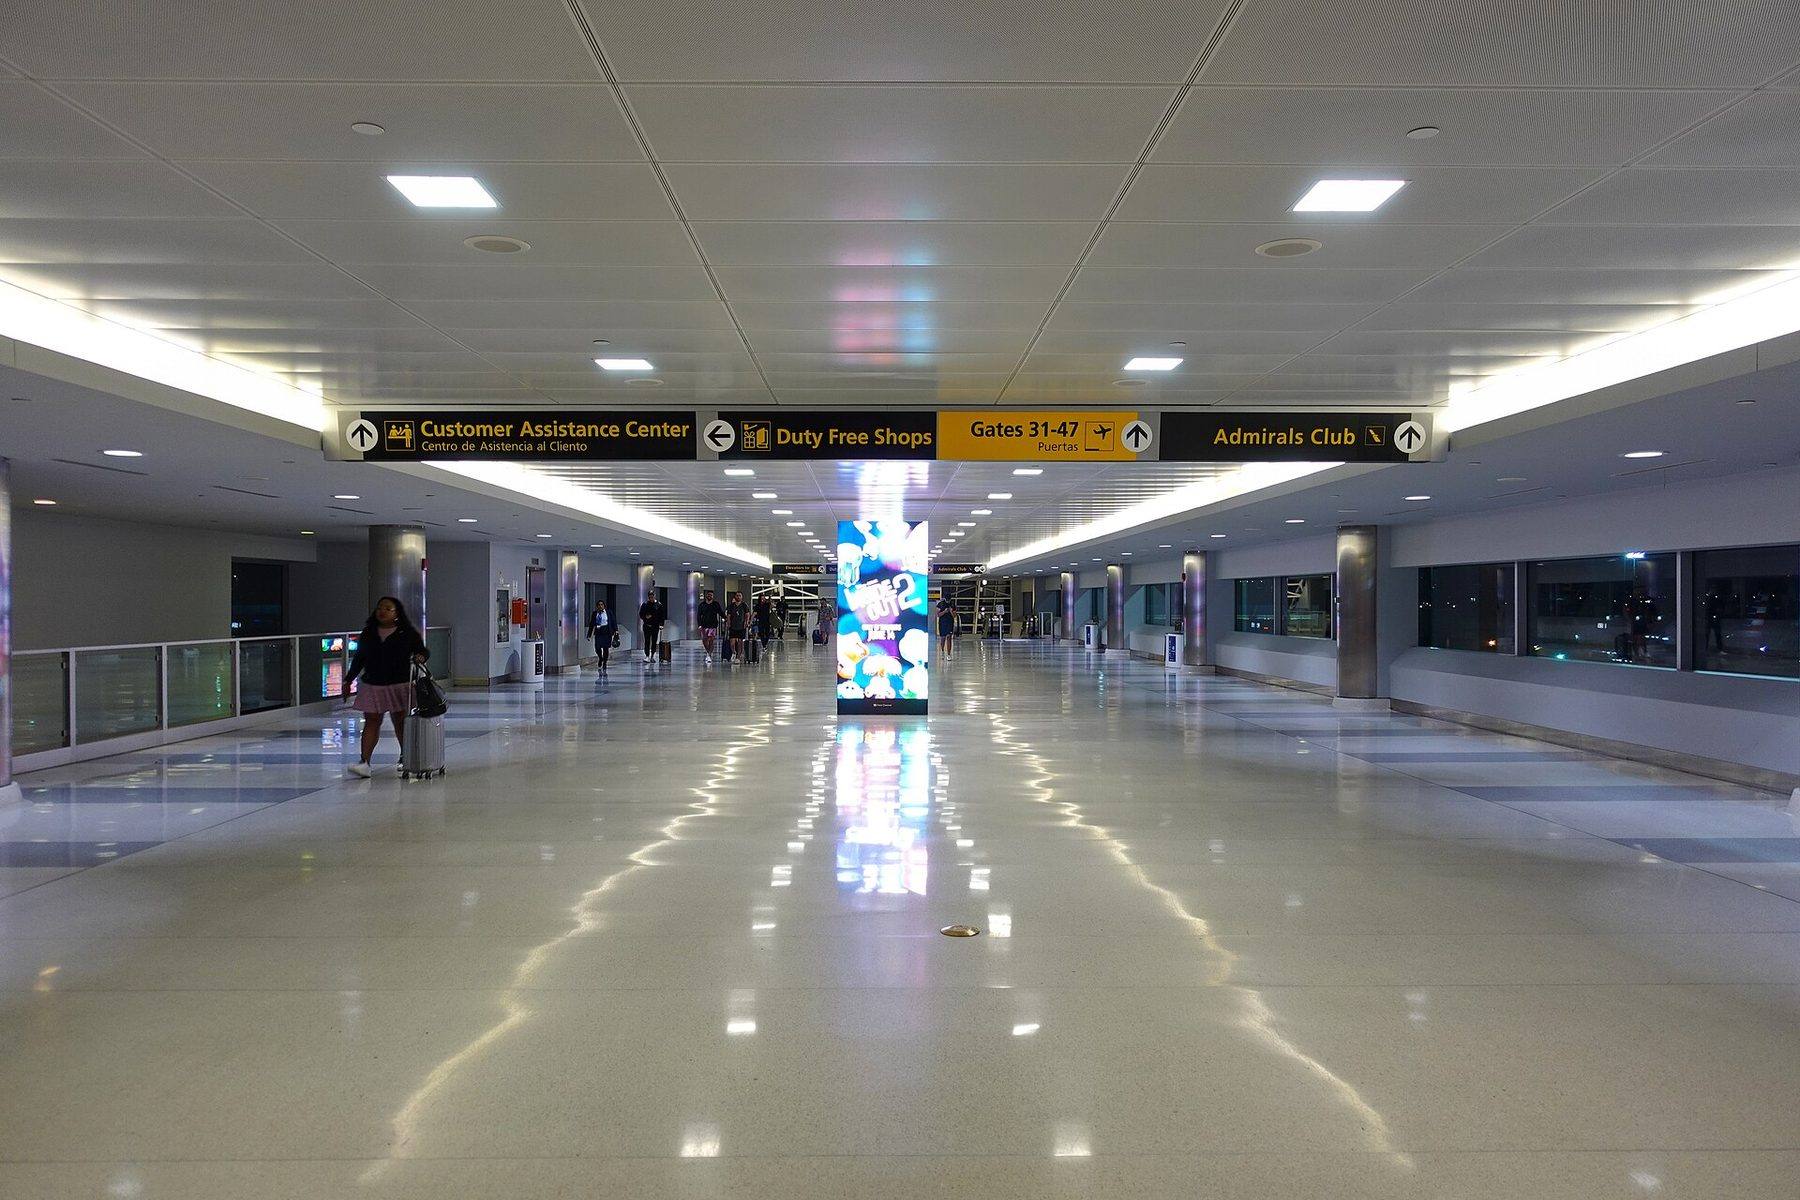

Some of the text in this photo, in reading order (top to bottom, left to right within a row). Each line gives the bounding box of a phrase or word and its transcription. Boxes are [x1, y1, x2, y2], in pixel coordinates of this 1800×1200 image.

[421, 420, 690, 438] Customer Assistance Center
[970, 420, 1079, 439] Gates 31-47
[1213, 428, 1356, 446] Admirals Club
[421, 440, 588, 452] Centro de Asistencia al Cliento
[777, 428, 932, 449] Duty Free Shops
[1038, 441, 1080, 453] Puertas
[843, 573, 922, 612] IDE 2
[866, 590, 900, 621] OUT
